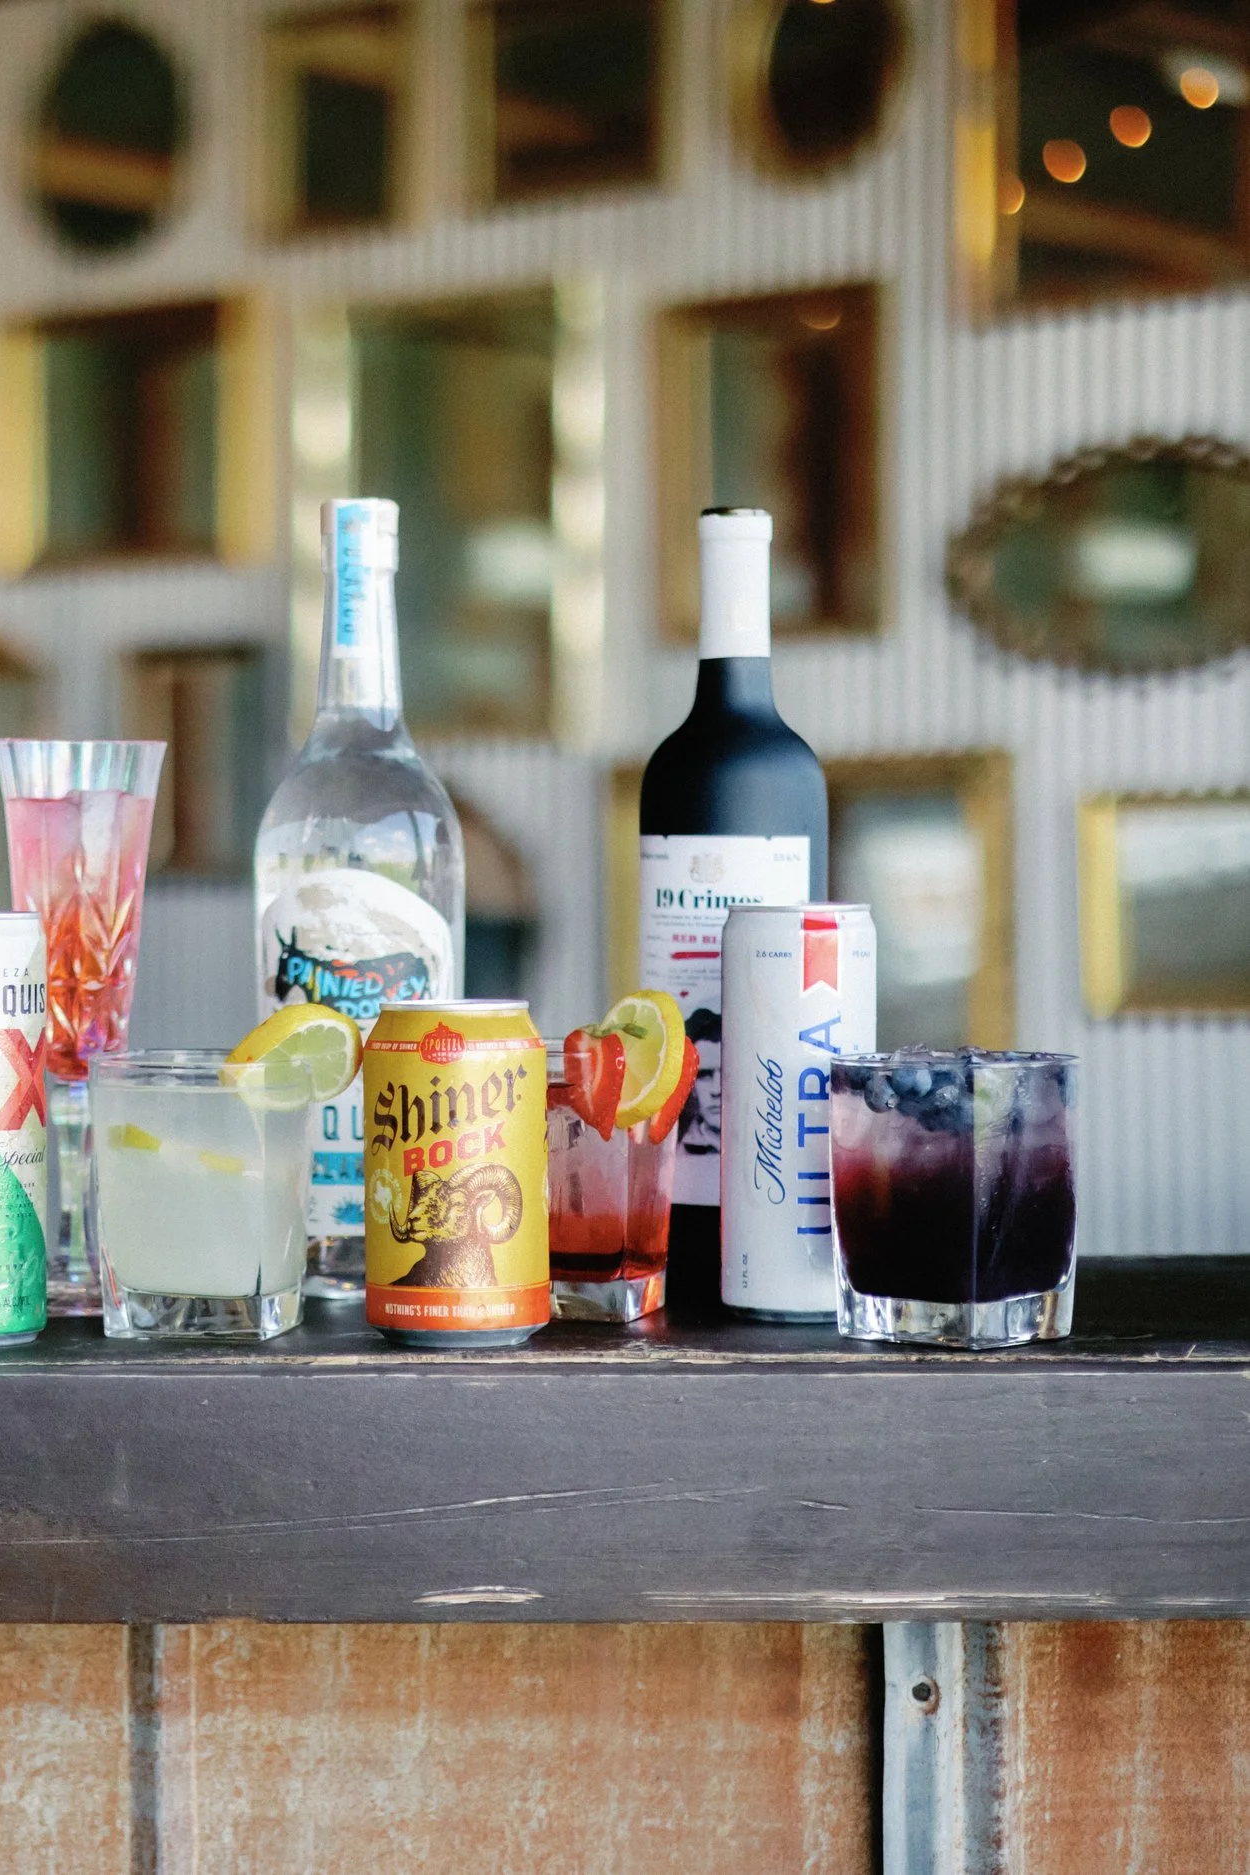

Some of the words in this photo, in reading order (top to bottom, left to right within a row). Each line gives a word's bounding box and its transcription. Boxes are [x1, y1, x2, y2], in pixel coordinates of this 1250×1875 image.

[755, 950, 767, 958] 2.6
[371, 1063, 528, 1156] Shiner
[753, 1051, 786, 1205] Michelob
[403, 1120, 507, 1178] BOCK
[385, 1303, 422, 1317] NOTHING'S
[424, 1305, 450, 1318] FINER
